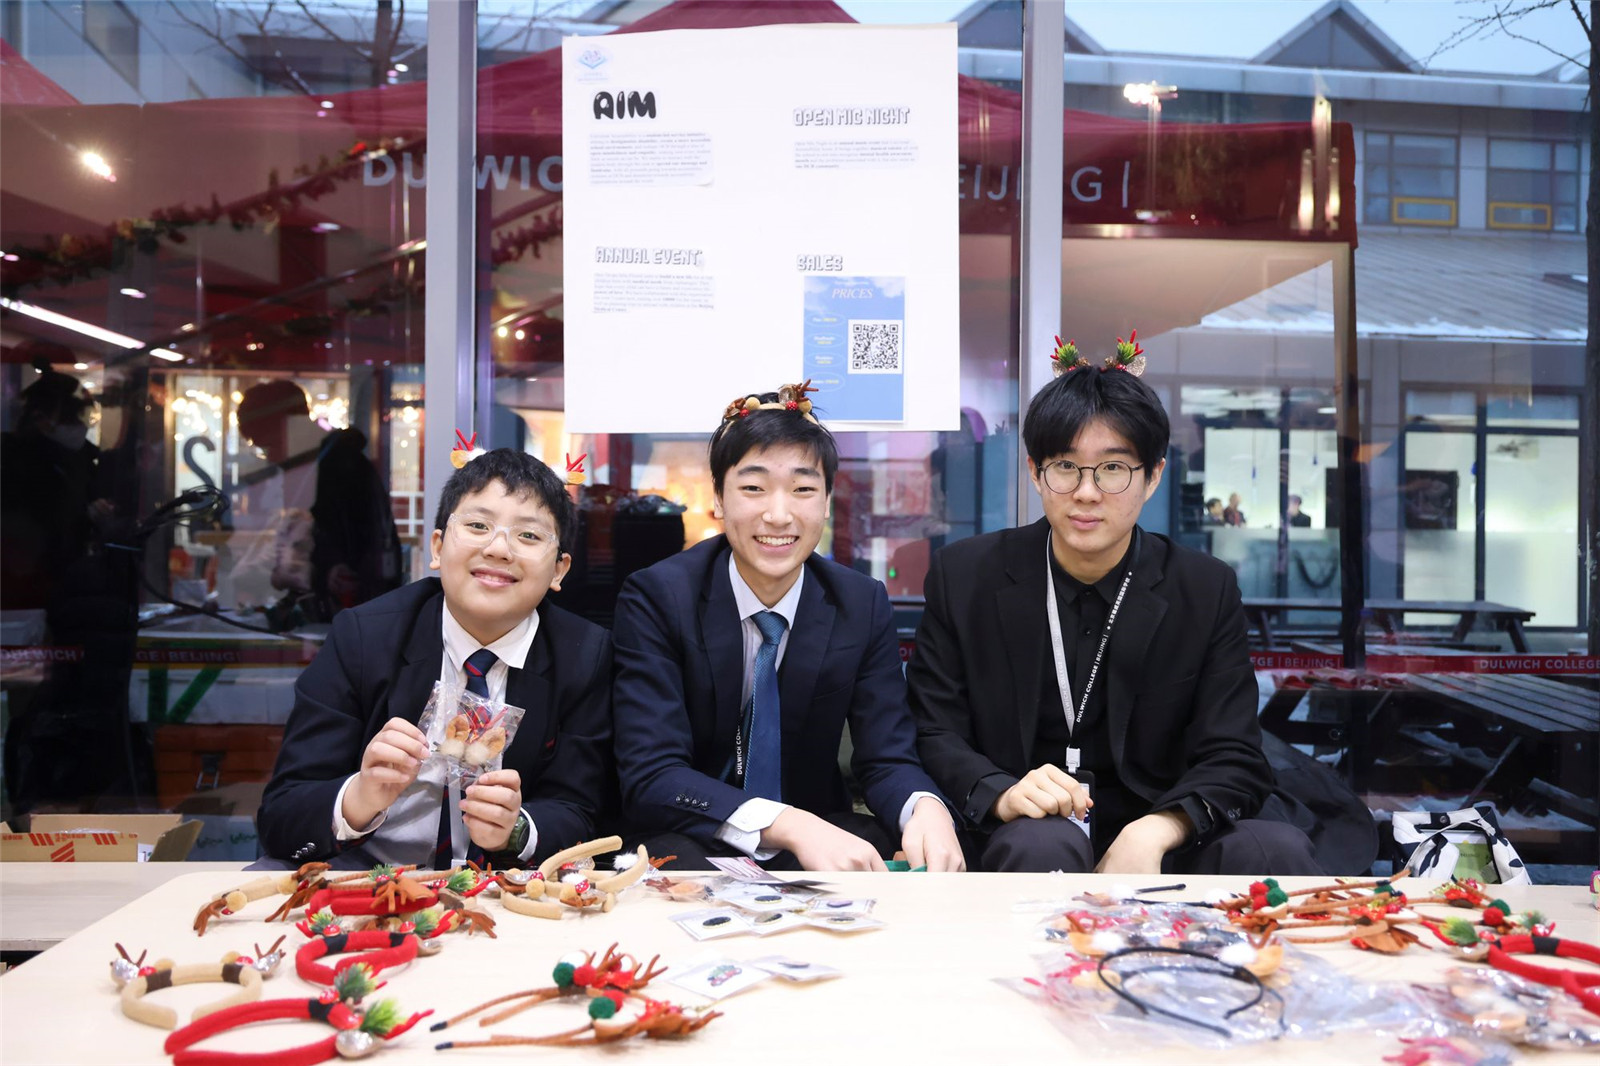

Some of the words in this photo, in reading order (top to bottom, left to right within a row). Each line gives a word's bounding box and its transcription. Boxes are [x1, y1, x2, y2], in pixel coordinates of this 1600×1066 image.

[593, 90, 656, 120] AIM
[794, 107, 833, 126] OPEN
[836, 107, 863, 126] MIC
[865, 106, 910, 125] NIGHT
[596, 246, 650, 264] ANNUAL
[653, 248, 703, 265] EVENT
[797, 254, 843, 271] SALES
[832, 288, 873, 299] PRICES
[168, 650, 236, 662] BEIJING
[1285, 657, 1335, 668] BEIJING
[1480, 659, 1541, 670] DULWICH
[1076, 693, 1090, 723] DULWICH
[1085, 665, 1098, 693] COLLEGE
[1096, 637, 1108, 662] BEIJING
